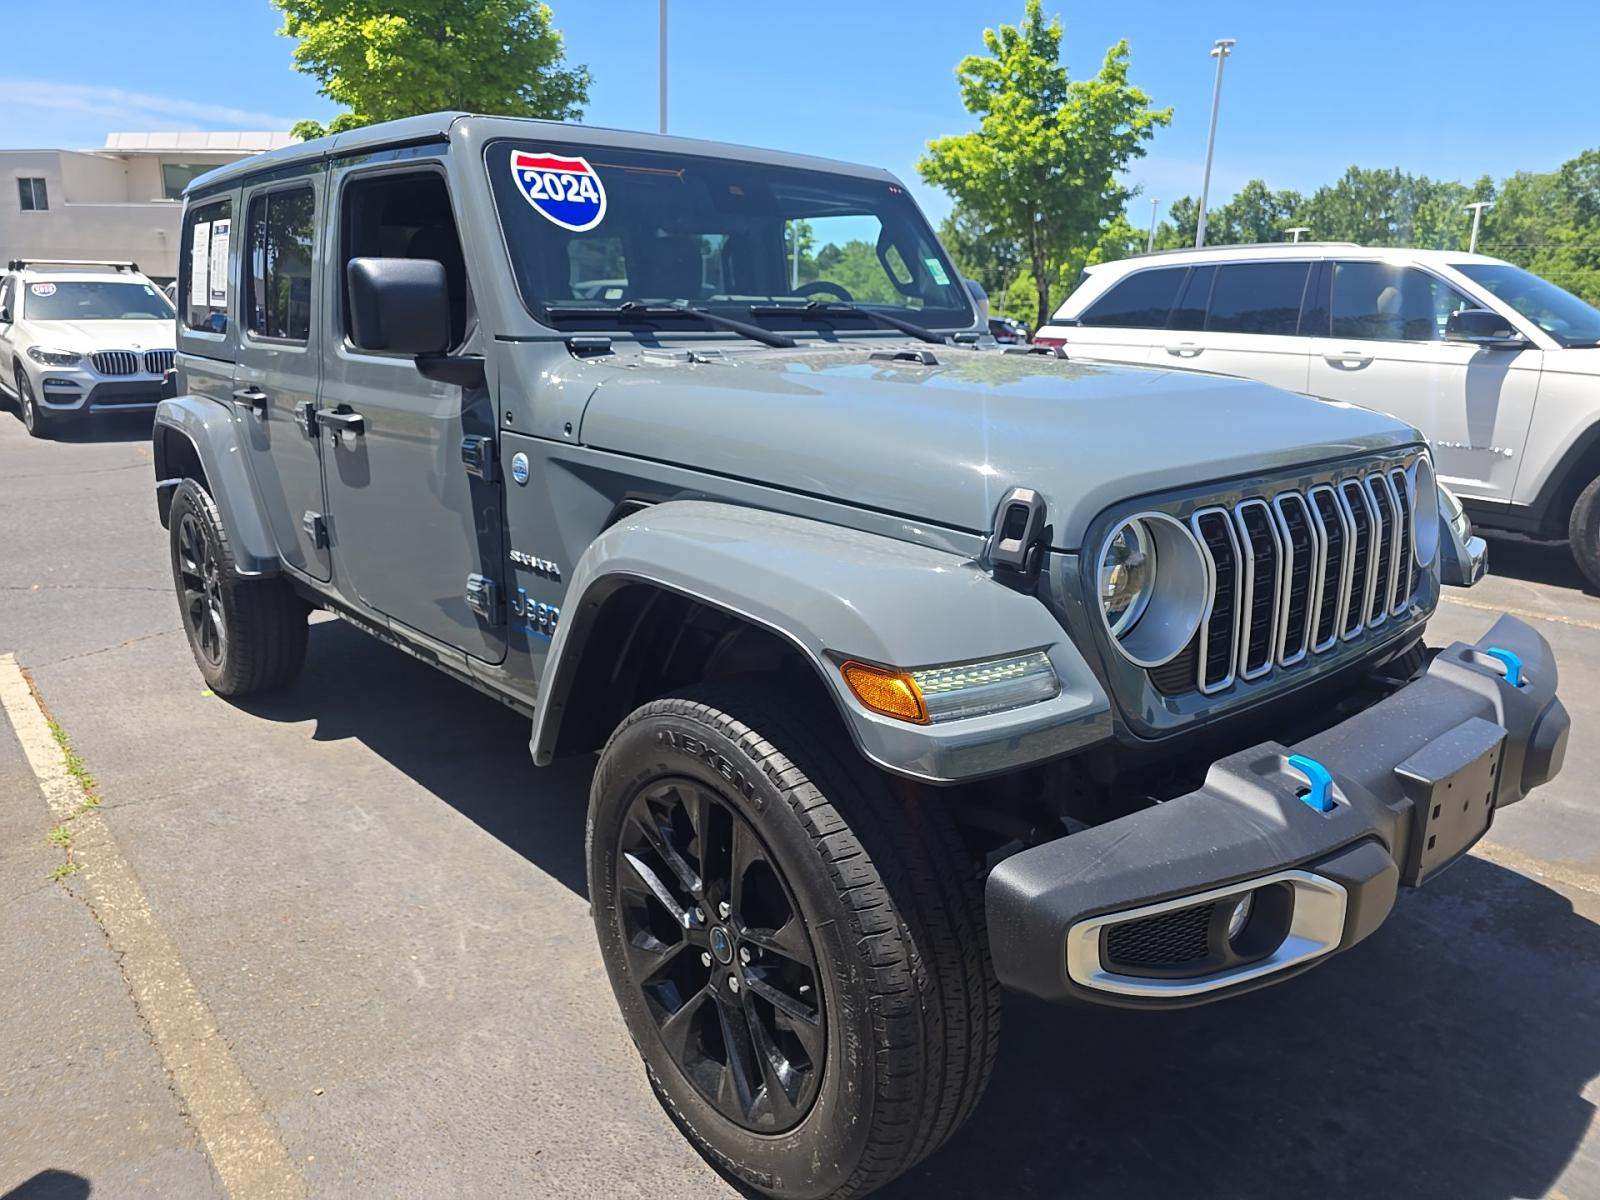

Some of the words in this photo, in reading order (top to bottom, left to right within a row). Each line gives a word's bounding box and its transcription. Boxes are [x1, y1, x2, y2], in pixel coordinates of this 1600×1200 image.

[523, 171, 599, 204] 2024
[511, 587, 560, 631] Jeep
[662, 729, 755, 800] NEXEN
